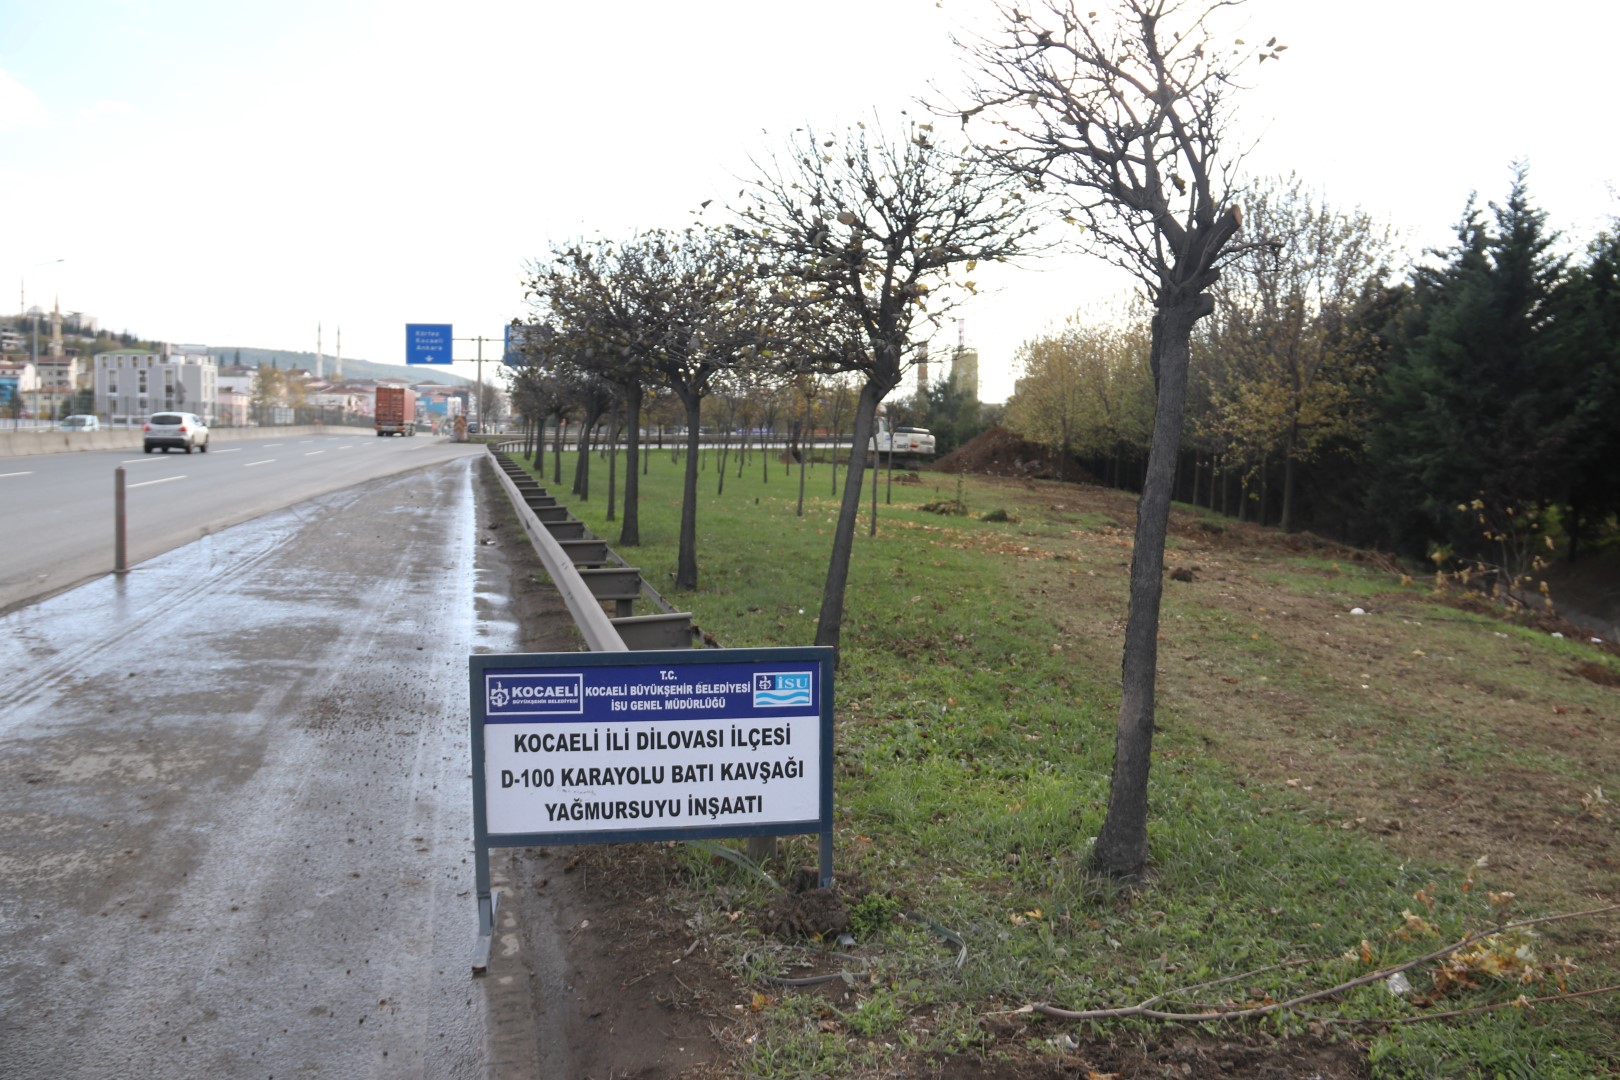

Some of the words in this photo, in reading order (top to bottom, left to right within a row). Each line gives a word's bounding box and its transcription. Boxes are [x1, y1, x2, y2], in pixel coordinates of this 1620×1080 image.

[660, 670, 677, 681] T.C.
[777, 675, 808, 690] İSU
[511, 683, 579, 698] KOCAELİ
[585, 684, 628, 697] KOCAELİ
[630, 682, 693, 698] BÜYÜKŞEHİR
[695, 681, 751, 695] BELEDİYESİ
[611, 698, 628, 711] İSU
[630, 699, 662, 711] GENEL
[665, 696, 726, 710] MÜDÜRLÜĞÜ
[514, 730, 599, 753] KOCAELİ
[606, 728, 629, 751] İLİ
[637, 726, 724, 750] DİLOVASI
[731, 723, 791, 751] İLÇESİ
[501, 768, 554, 788] D-100
[561, 765, 665, 787] KARAYOLU
[672, 763, 714, 784] BATI
[721, 756, 804, 784] KAVŞAĞI
[545, 798, 681, 822] YAĞMURSUYU
[688, 795, 763, 820] İNŞAATI
